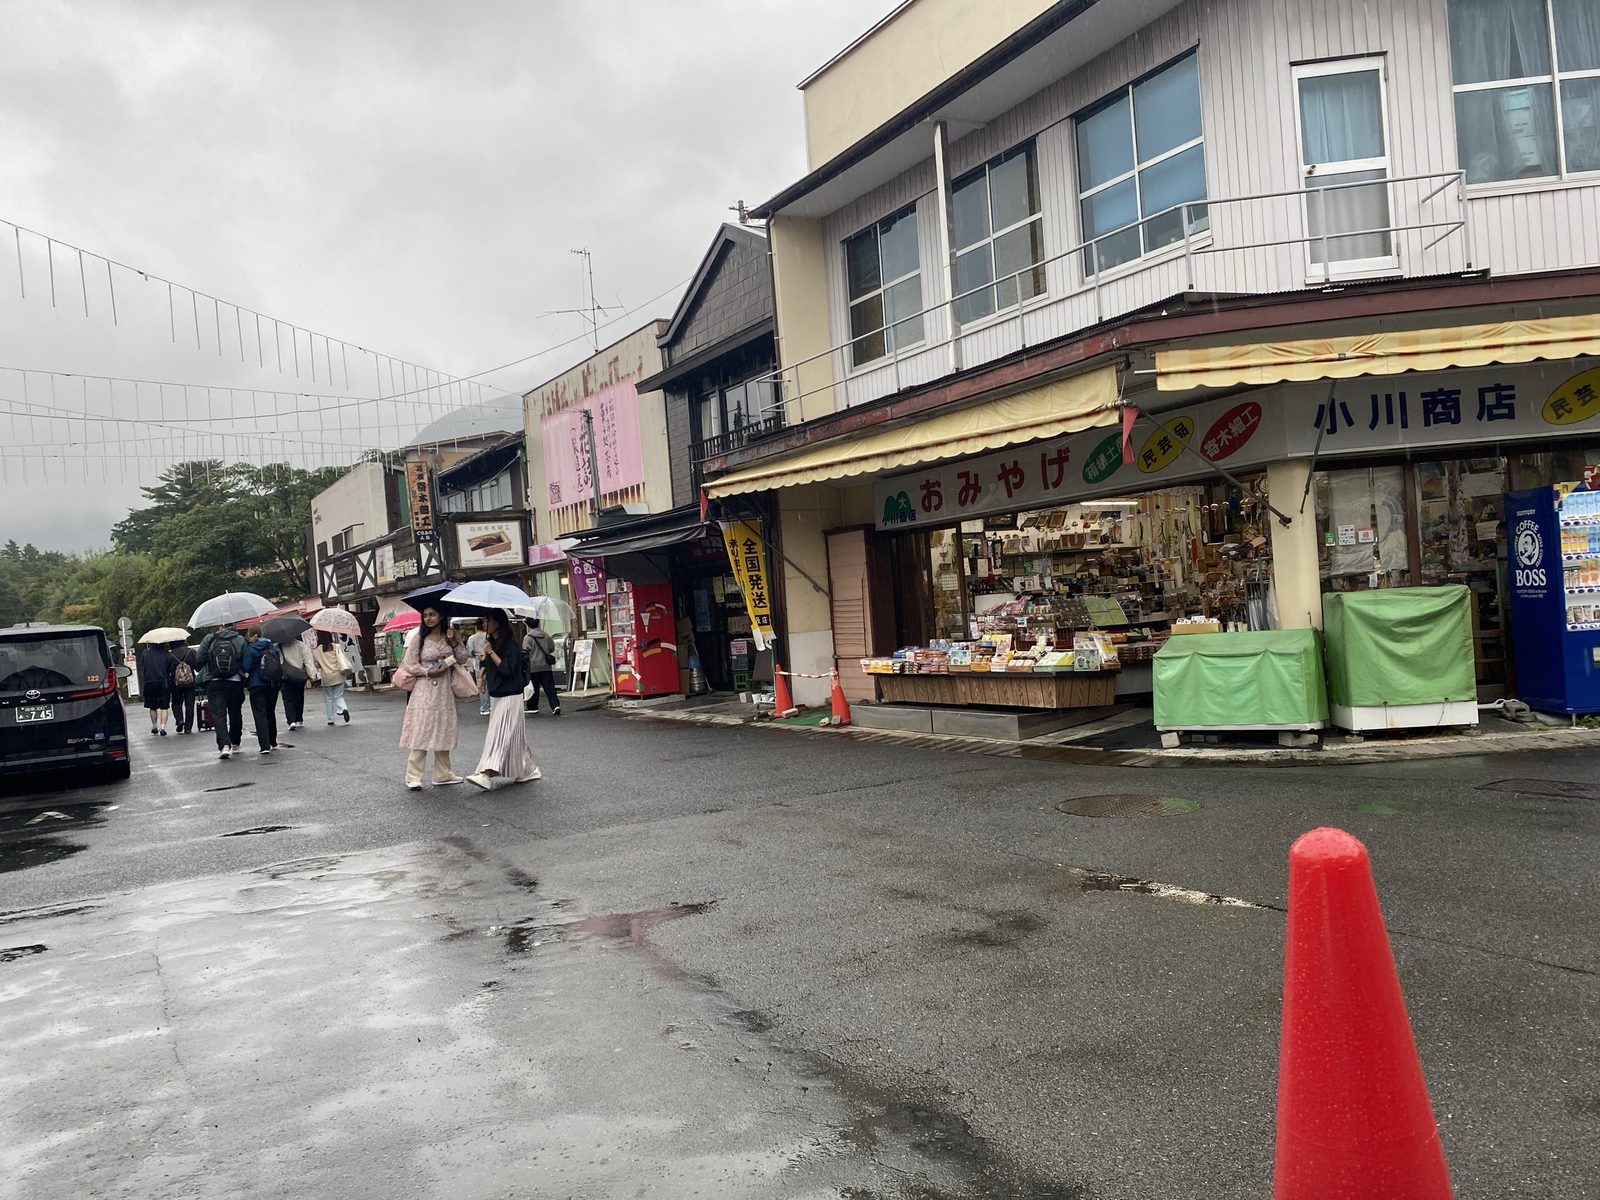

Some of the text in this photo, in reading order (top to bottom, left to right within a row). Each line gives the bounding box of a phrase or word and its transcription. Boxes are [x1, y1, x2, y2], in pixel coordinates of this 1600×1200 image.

[1313, 383, 1517, 435] 小川商店
[1550, 378, 1600, 420] 民芸
[1142, 421, 1190, 469] 民芸品
[1203, 405, 1259, 459] 寄木細工
[919, 447, 1071, 513] おみやげ
[1516, 520, 1539, 534] COFFEE
[743, 538, 767, 608] 全国発送
[1516, 569, 1546, 586] BOSS
